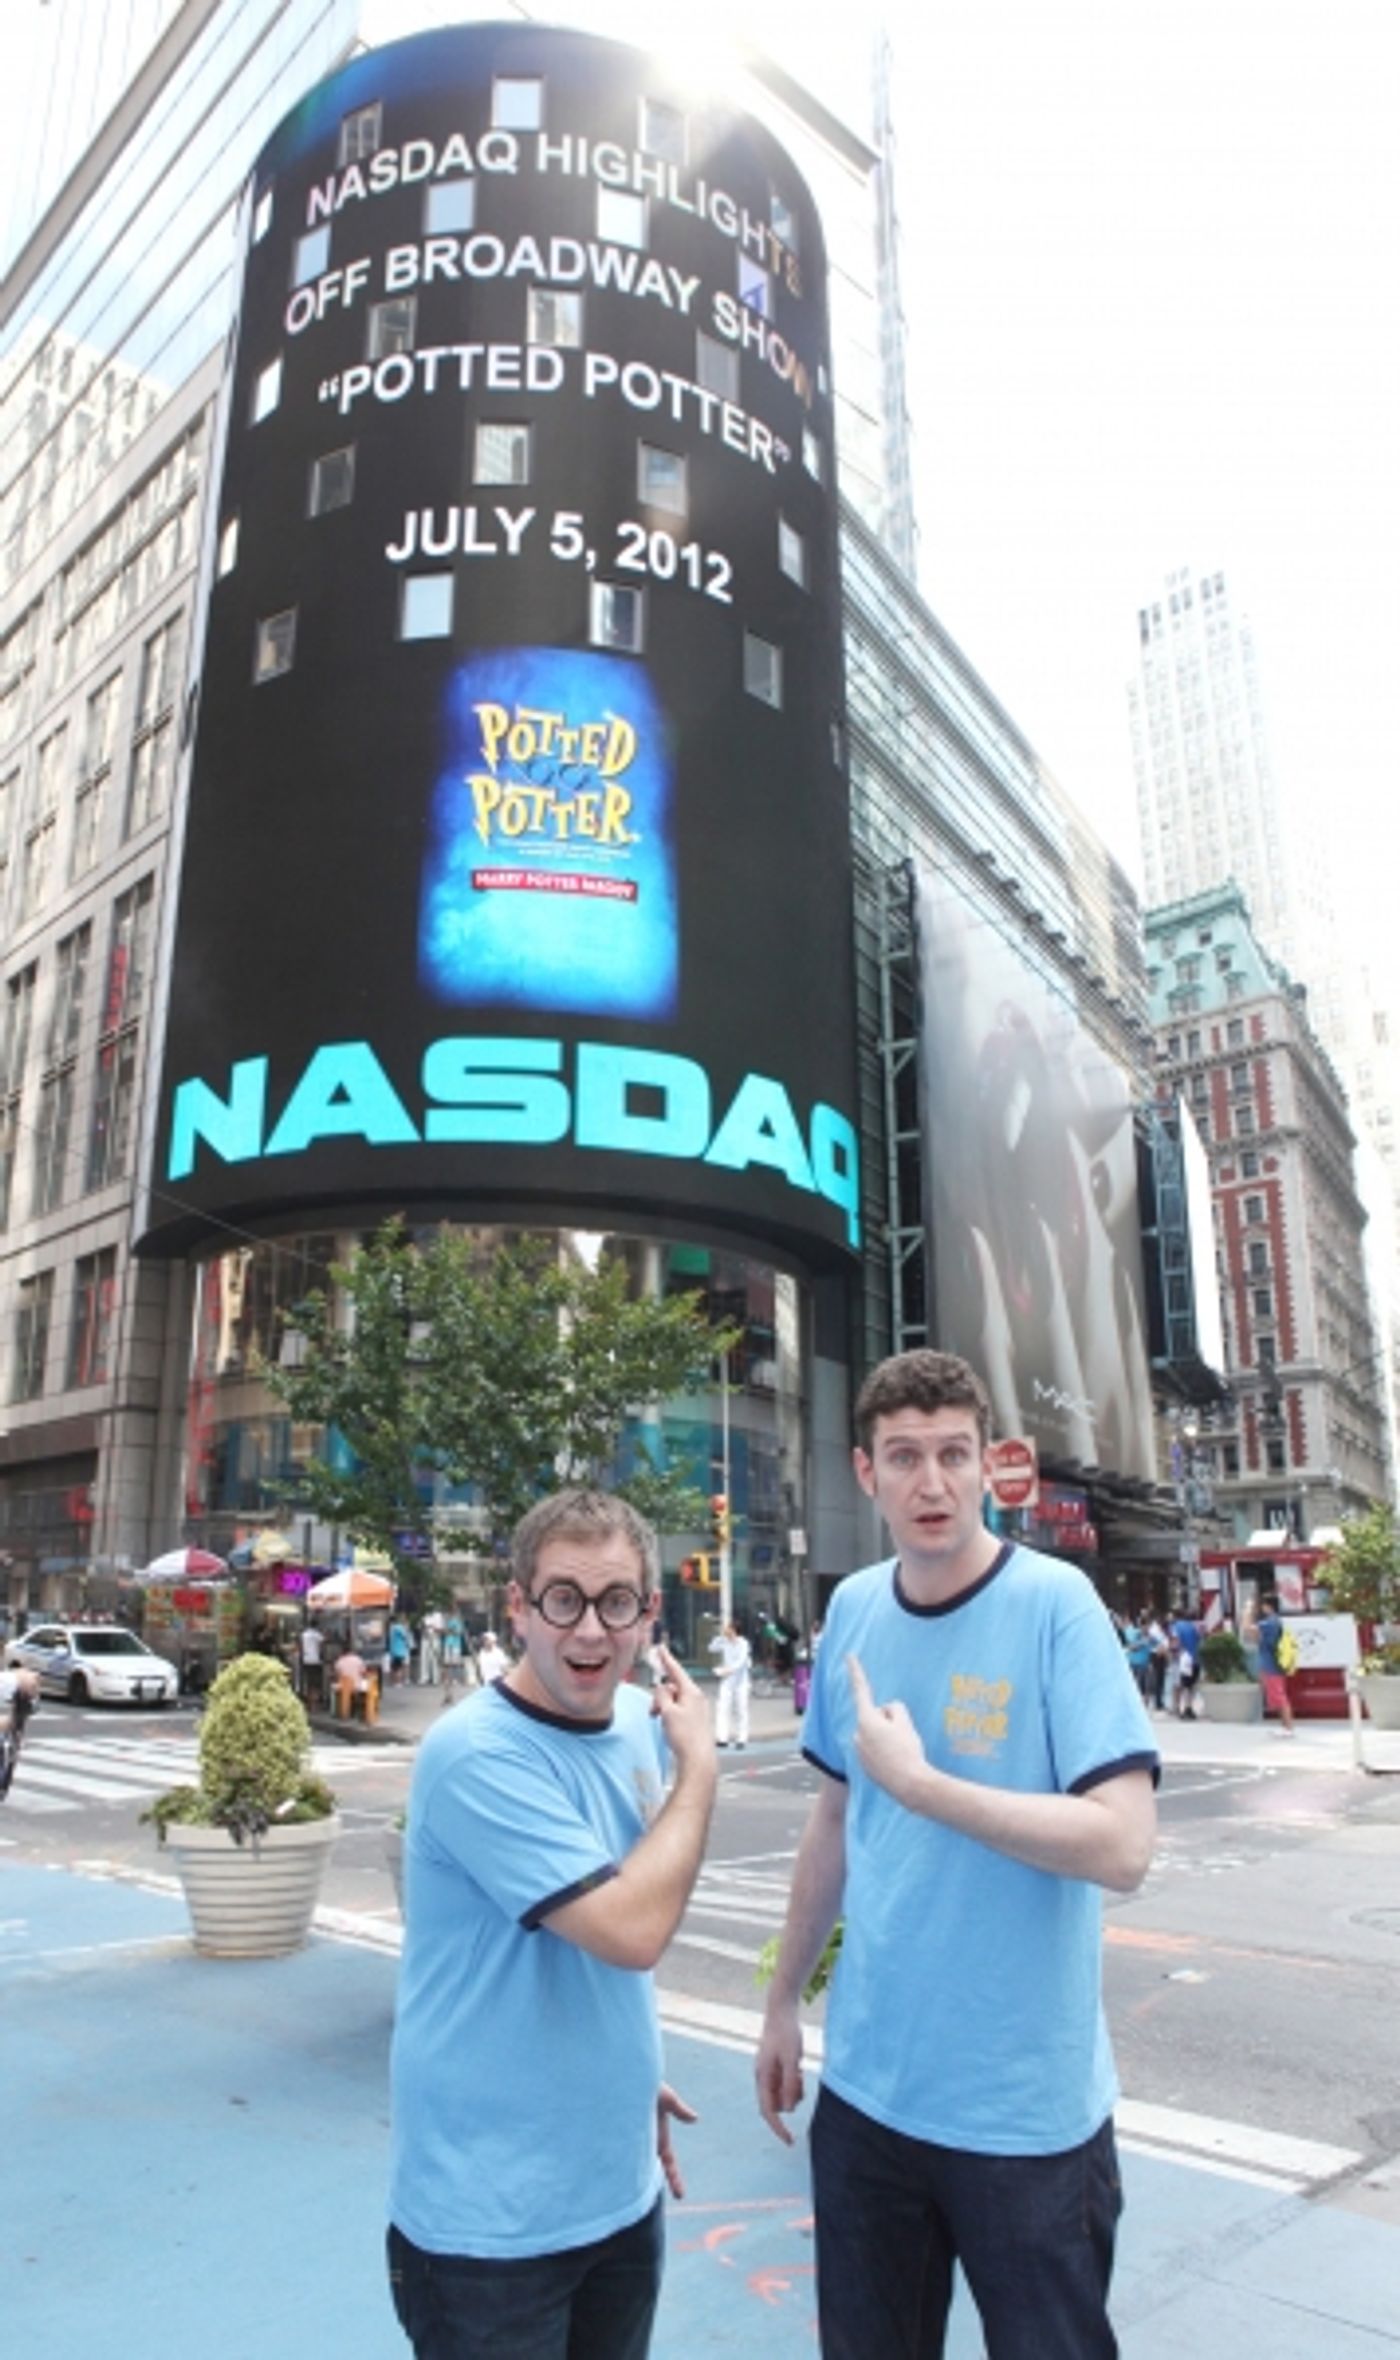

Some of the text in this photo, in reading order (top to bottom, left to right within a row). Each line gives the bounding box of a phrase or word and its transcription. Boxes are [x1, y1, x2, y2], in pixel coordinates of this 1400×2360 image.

[306, 132, 802, 298] NASDAQ HIGHLIGHTS
[285, 260, 370, 334] OFF
[384, 235, 700, 312] BROADWAY
[386, 507, 733, 603] JULY 5, 2012
[472, 702, 636, 776] POTTED
[168, 1037, 860, 1249] NASDAQ
